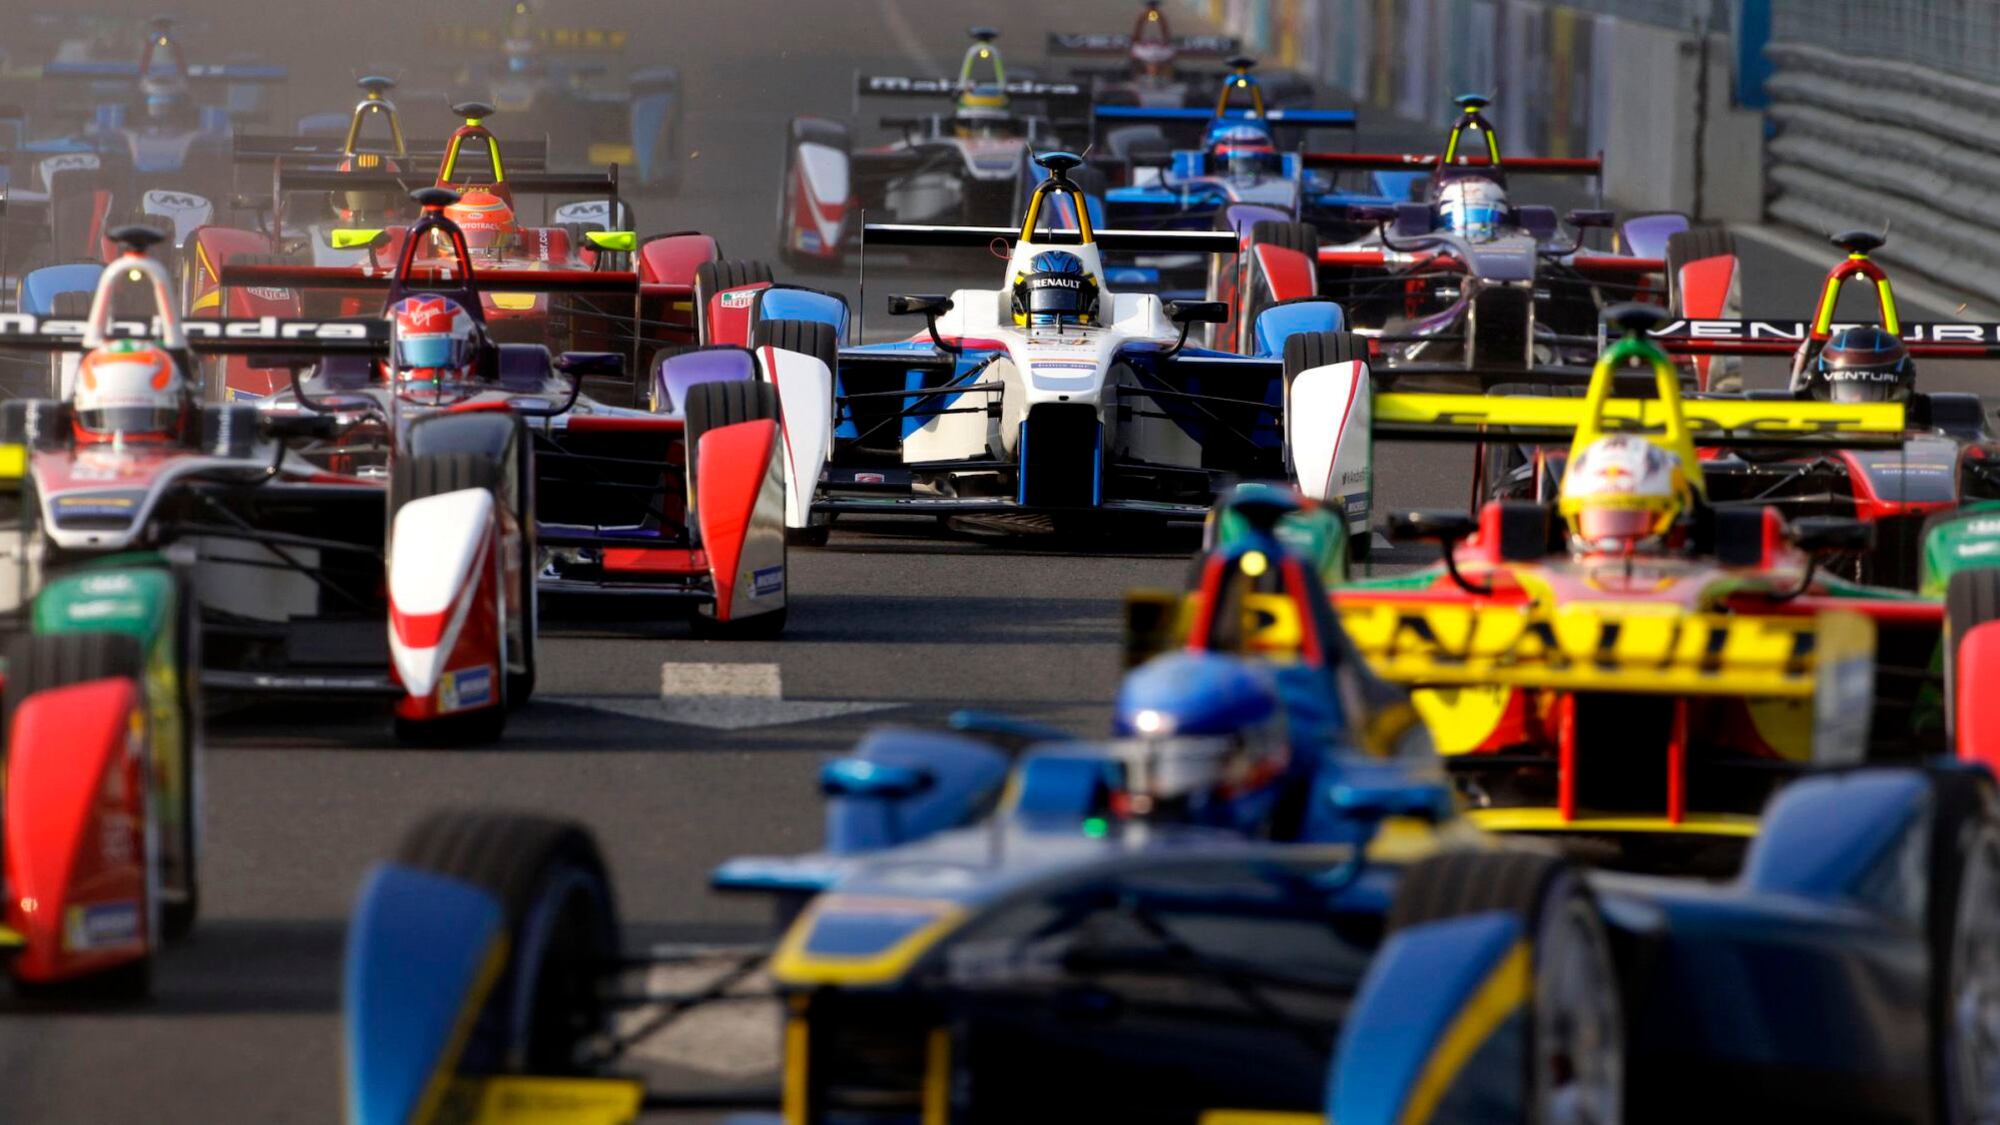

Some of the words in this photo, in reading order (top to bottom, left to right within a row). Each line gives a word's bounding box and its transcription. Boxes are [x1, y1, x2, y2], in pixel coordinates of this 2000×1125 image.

[869, 77, 1079, 94] Mahdra
[1032, 278, 1081, 289] RENAULT
[1822, 370, 1899, 383] VENTURI
